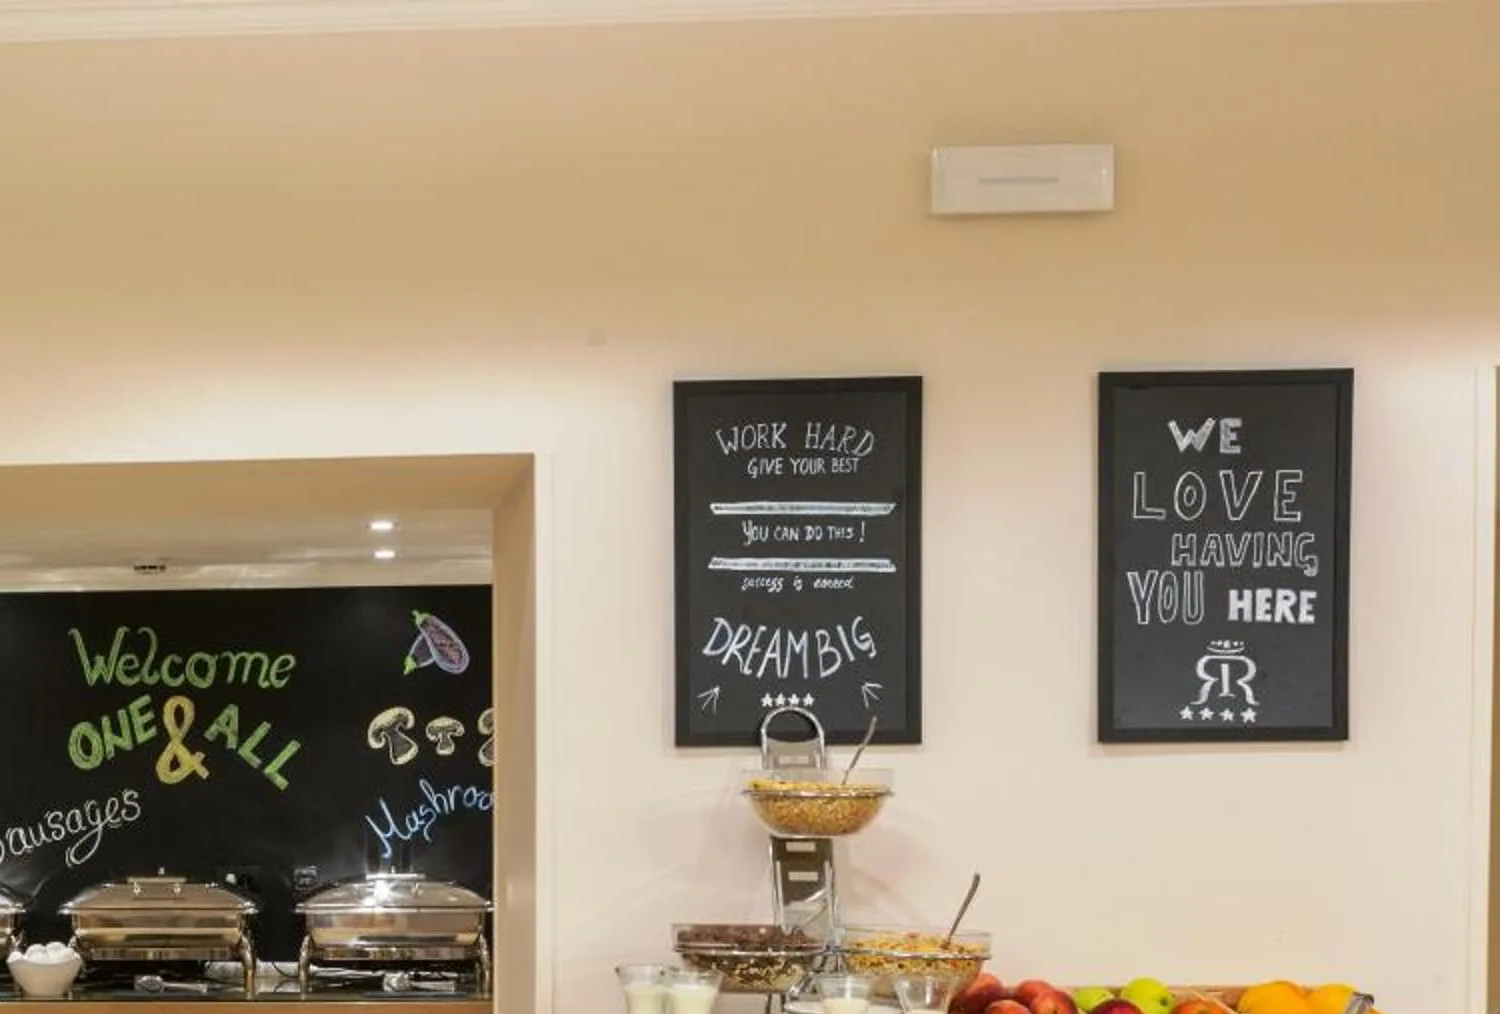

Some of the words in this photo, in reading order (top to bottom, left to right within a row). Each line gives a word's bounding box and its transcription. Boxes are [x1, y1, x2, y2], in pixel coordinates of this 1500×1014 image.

[715, 421, 787, 456] WORK
[804, 421, 875, 457] HARD
[1167, 416, 1243, 454] WE
[747, 456, 785, 479] GIVE
[789, 457, 827, 477] YOUR
[831, 457, 861, 474] BEST
[1132, 469, 1303, 522] LOVE
[741, 519, 769, 547] YOU
[773, 525, 799, 542] CAN
[804, 525, 823, 541] DO
[1170, 532, 1319, 577] HAVING
[1126, 570, 1205, 625] YOU
[1228, 588, 1317, 624] HERE
[68, 625, 298, 690] Welcome
[702, 617, 809, 680] DREAM
[815, 615, 878, 679] BIG
[67, 694, 159, 772] ONE
[155, 695, 211, 785] &
[204, 703, 300, 791] ALL
[365, 778, 493, 859] Mushroo
